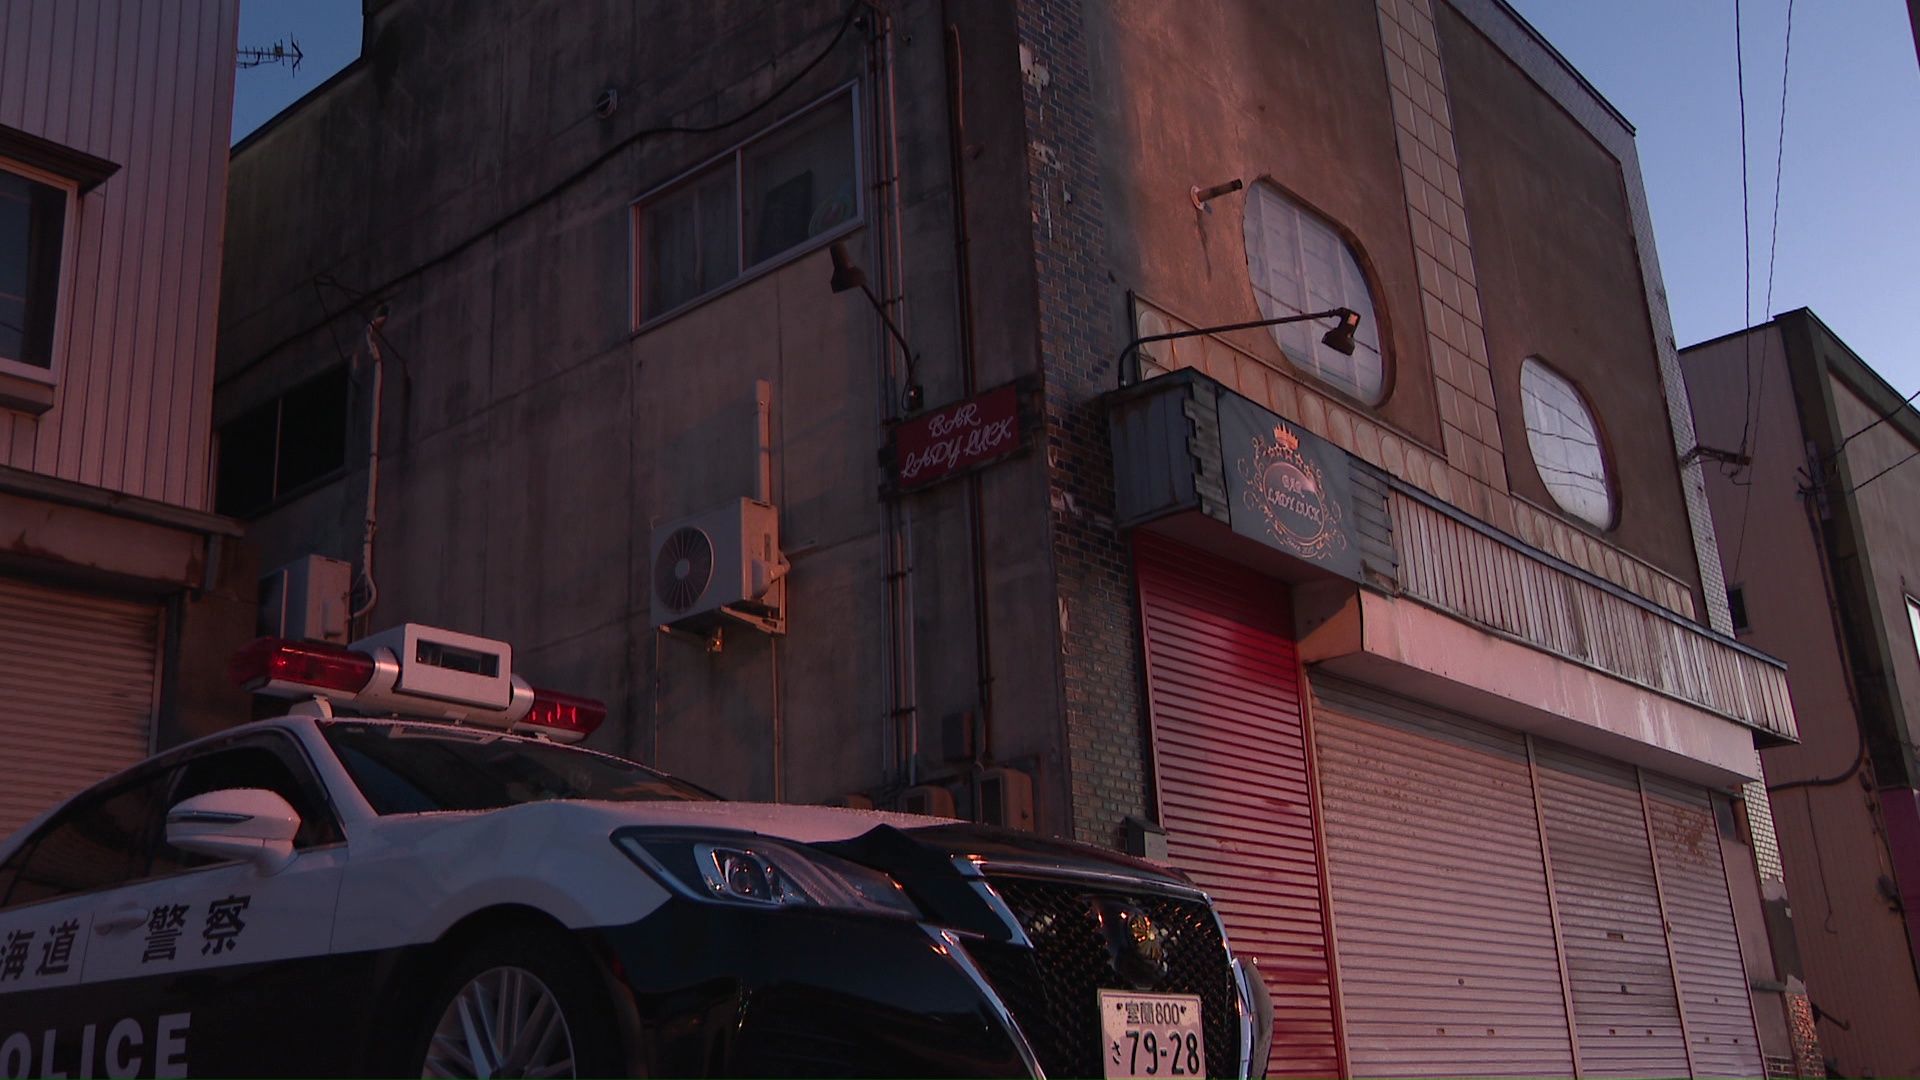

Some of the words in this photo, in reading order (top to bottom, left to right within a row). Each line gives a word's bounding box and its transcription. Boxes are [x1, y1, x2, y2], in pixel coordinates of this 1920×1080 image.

[928, 403, 981, 437] BAR
[901, 436, 963, 478] LADY
[964, 415, 1014, 456] LUCK
[1267, 487, 1295, 511] LADY
[1296, 501, 1321, 525] LUCK
[1282, 474, 1305, 498] BAR
[0, 1012, 192, 1080] OLICE
[1112, 1041, 1121, 1065] さ
[1126, 1030, 1200, 1075] 79-28
